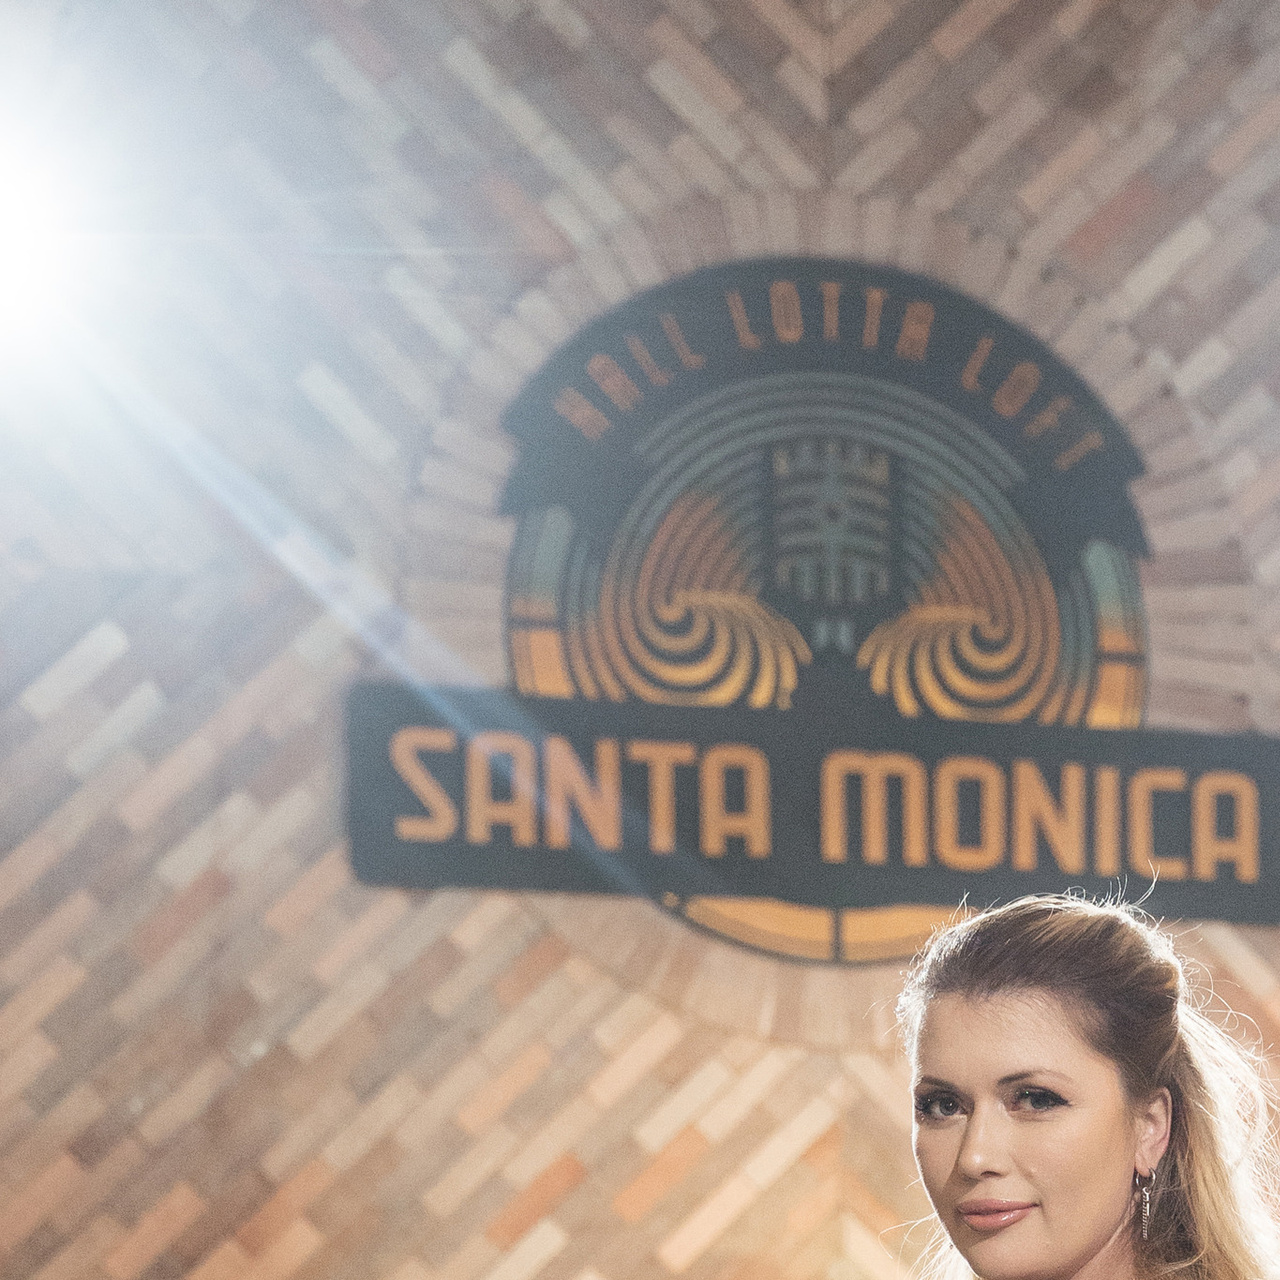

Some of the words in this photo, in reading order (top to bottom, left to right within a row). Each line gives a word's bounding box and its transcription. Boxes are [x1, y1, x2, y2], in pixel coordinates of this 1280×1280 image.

[726, 280, 936, 361] LOTTA
[960, 337, 1104, 471] LOFT
[388, 727, 773, 860] SANTA
[821, 750, 1261, 884] MONICA
